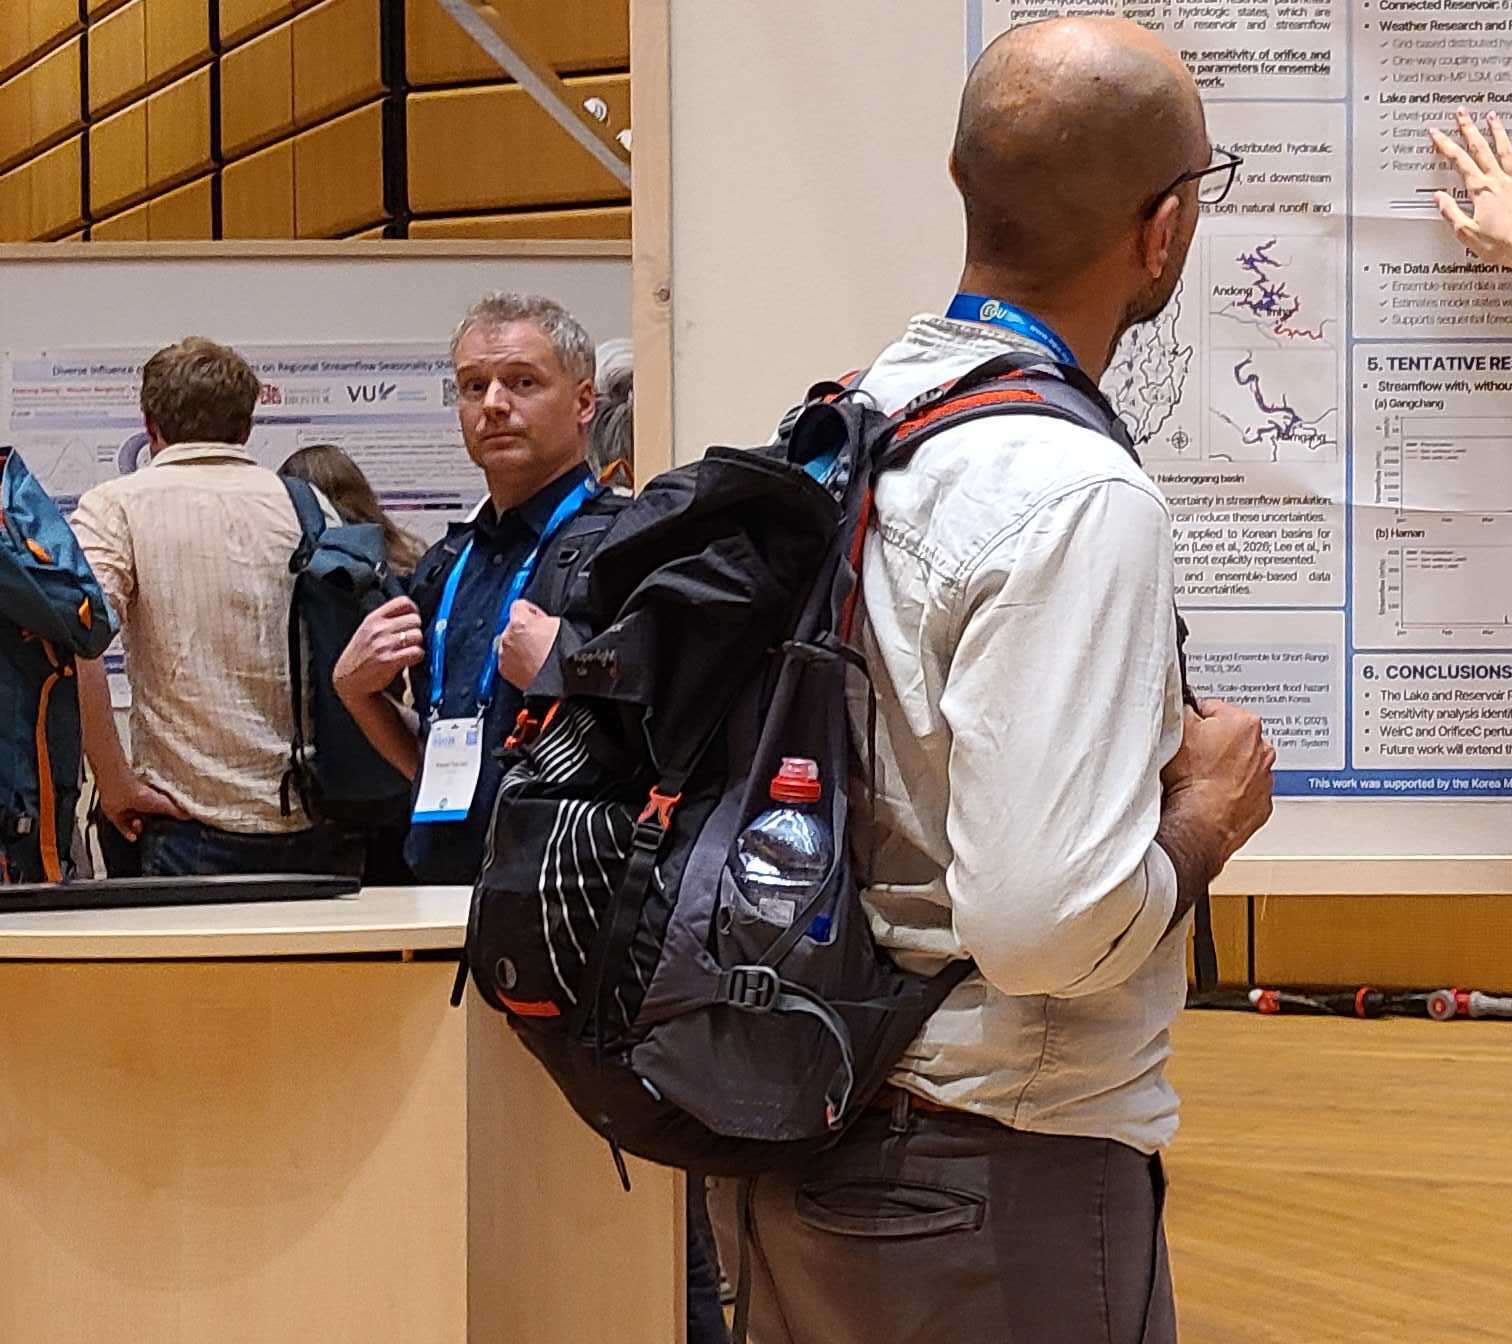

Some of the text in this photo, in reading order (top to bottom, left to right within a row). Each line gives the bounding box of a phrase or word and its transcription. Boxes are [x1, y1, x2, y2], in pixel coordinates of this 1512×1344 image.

[1380, 21, 1427, 31] Weather
[1430, 20, 1482, 31] Research
[1485, 20, 1505, 31] and
[1380, 93, 1406, 103] Lake
[1409, 93, 1429, 103] and
[1433, 93, 1484, 103] Reservoir
[1380, 263, 1499, 273] The Data Assimilation
[1212, 286, 1252, 297] Andong
[1367, 357, 1383, 371] 5.
[1386, 356, 1486, 370] TENTATIVE
[1378, 380, 1442, 392] Streamflow
[347, 385, 377, 402] VU
[1363, 665, 1512, 679] 6. CONCLUSIONS
[1380, 690, 1401, 701] The
[1403, 690, 1429, 700] Lake
[1432, 690, 1452, 700] and
[1455, 690, 1504, 701] Reservoir
[1380, 708, 1434, 721] Sensitivity
[1436, 707, 1479, 721] analysis
[1380, 726, 1413, 737] WeirC
[1416, 726, 1435, 737] and
[1438, 726, 1481, 737] OrificeC
[1380, 744, 1414, 754] Future
[1417, 745, 1444, 754] work
[1446, 744, 1463, 754] will
[1465, 744, 1502, 755] extend
[1308, 778, 1330, 788] This
[1332, 778, 1356, 788] work
[1359, 780, 1380, 788] was
[1383, 778, 1434, 790] supported
[1452, 779, 1468, 788] the
[1471, 778, 1501, 788] Korea
